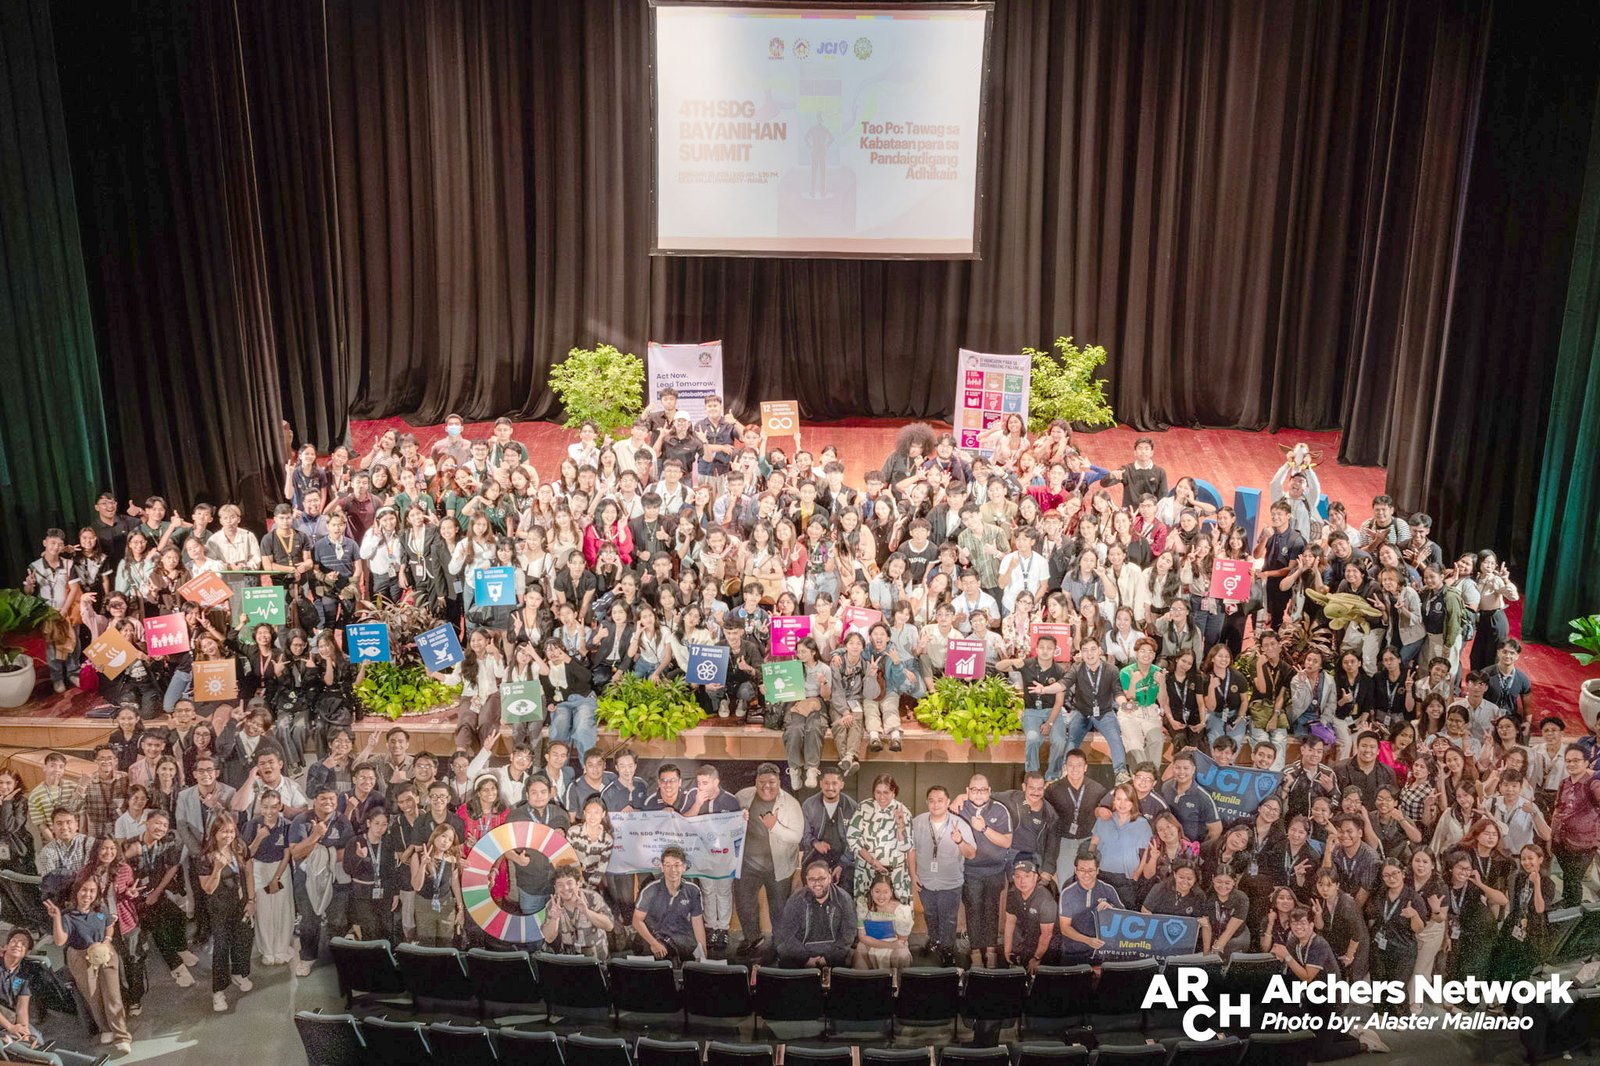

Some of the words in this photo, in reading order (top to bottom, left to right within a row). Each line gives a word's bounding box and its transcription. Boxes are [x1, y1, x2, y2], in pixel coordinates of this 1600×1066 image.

[816, 42, 838, 54] JCI
[680, 100, 714, 118] 4TH
[717, 100, 755, 118] SDG
[679, 122, 787, 140] BAYANIHAN
[861, 121, 884, 134] Tao
[885, 121, 904, 134] Po:
[905, 121, 945, 137] Tawag
[947, 124, 960, 135] sa
[860, 137, 916, 149] Kabataan
[918, 139, 944, 151] para
[946, 139, 959, 149] sa
[679, 144, 752, 161] SUMMIT
[870, 151, 959, 167] Pandaigdigang
[905, 167, 958, 180] Adhikain
[1215, 561, 1221, 570] 5
[476, 571, 482, 580] 6
[245, 590, 251, 599] 3
[847, 609, 852, 618] 4
[146, 621, 151, 630] 1
[773, 619, 781, 628] 10
[348, 627, 358, 636] 14
[1033, 625, 1038, 634] 9
[418, 636, 427, 647] 16
[949, 641, 955, 650] 8
[88, 649, 97, 658] 2
[691, 646, 700, 656] 17
[196, 664, 201, 673] 7
[764, 666, 773, 676] 15
[503, 686, 511, 695] 13
[1196, 764, 1253, 794] JCI
[1211, 791, 1241, 805] Manila
[1227, 807, 1237, 816] OF
[1100, 914, 1159, 940] JCI
[1119, 940, 1152, 950] Manila
